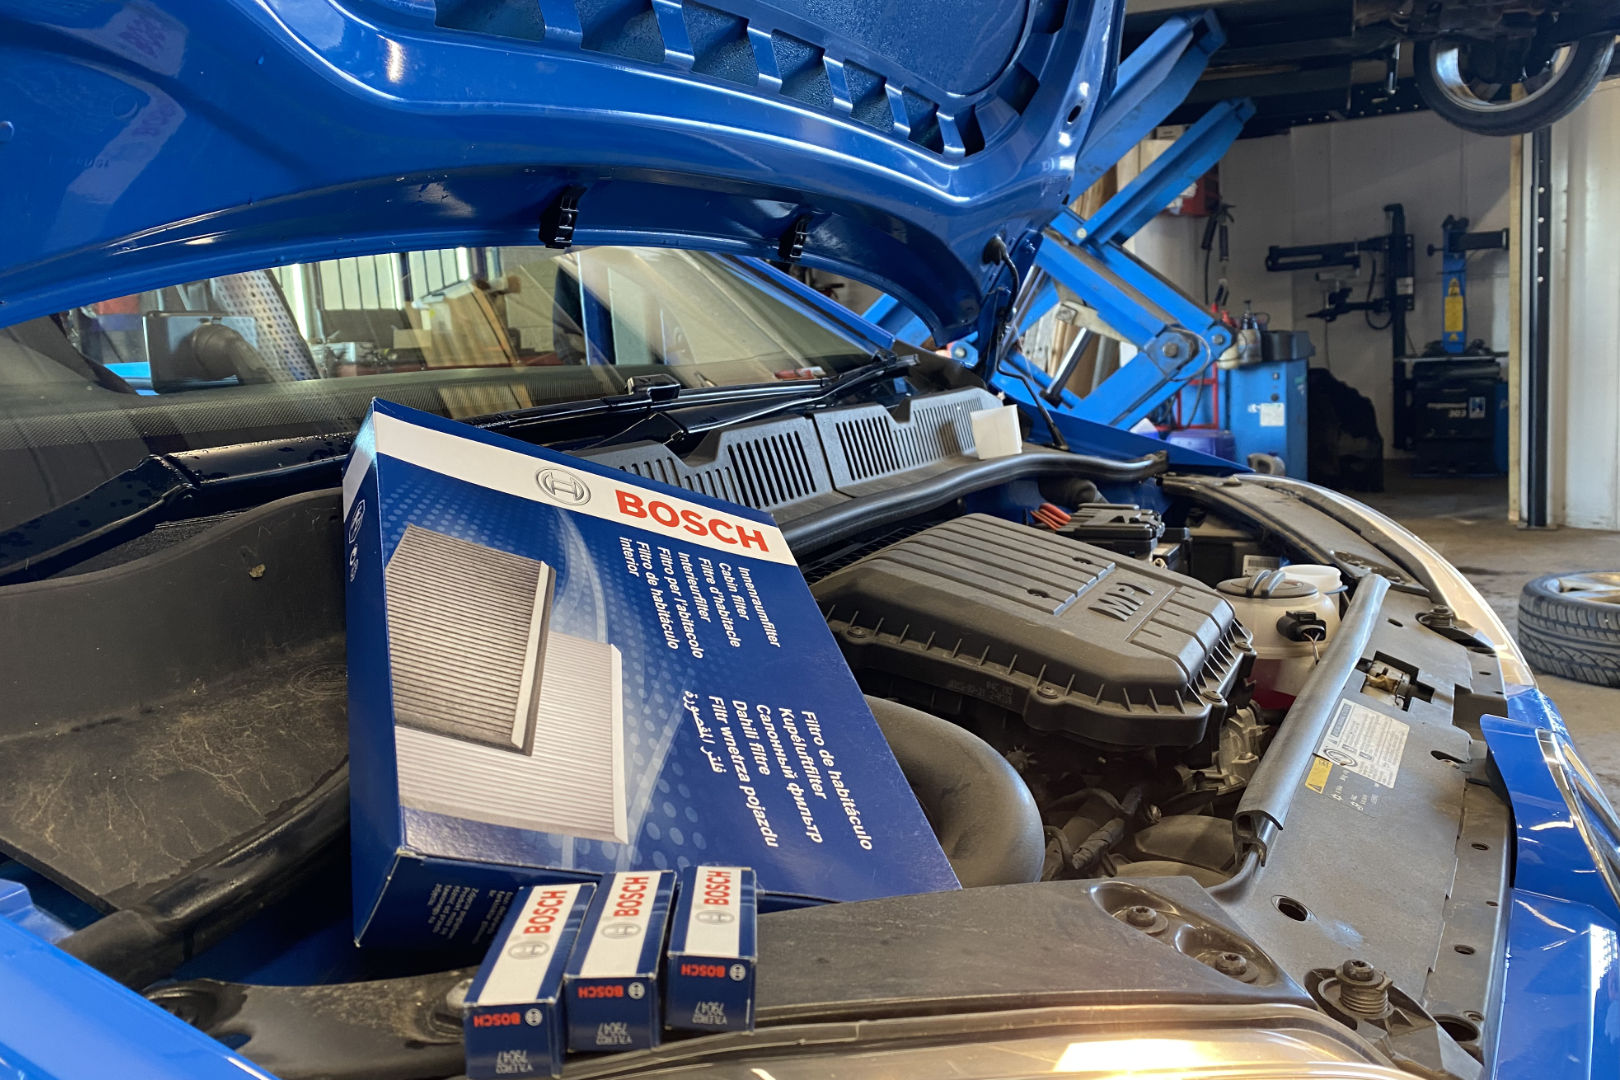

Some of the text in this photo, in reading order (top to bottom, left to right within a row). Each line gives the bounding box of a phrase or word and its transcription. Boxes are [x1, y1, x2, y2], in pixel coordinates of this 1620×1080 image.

[615, 489, 770, 553] BOSCH
[619, 536, 640, 577] interior
[636, 541, 680, 650] Filtro de habitáculo
[657, 546, 705, 659] Filtro per l'abitacolo
[677, 551, 712, 623] Interieurfilter
[698, 557, 742, 648] Filtre d'habitacle
[718, 562, 750, 621] Cabin filter
[737, 566, 781, 648] Innenraumfilter
[1087, 582, 1156, 623] MPI
[682, 690, 727, 773] فلتر المقصورة
[732, 700, 771, 777] Dahili filtre
[778, 707, 828, 800] Kupéluftfilter
[708, 695, 779, 848] Filtr wnetrza pojazdu
[756, 704, 824, 844] Салонный фильтр
[801, 710, 873, 851] Filtro de habitáculo
[523, 890, 568, 934] BOSCH
[613, 876, 650, 917] BOSCH
[704, 870, 732, 906] BOSCH
[578, 985, 624, 999] BOSCH
[681, 963, 726, 978] BOSCH
[473, 1012, 521, 1027] BOSCH
